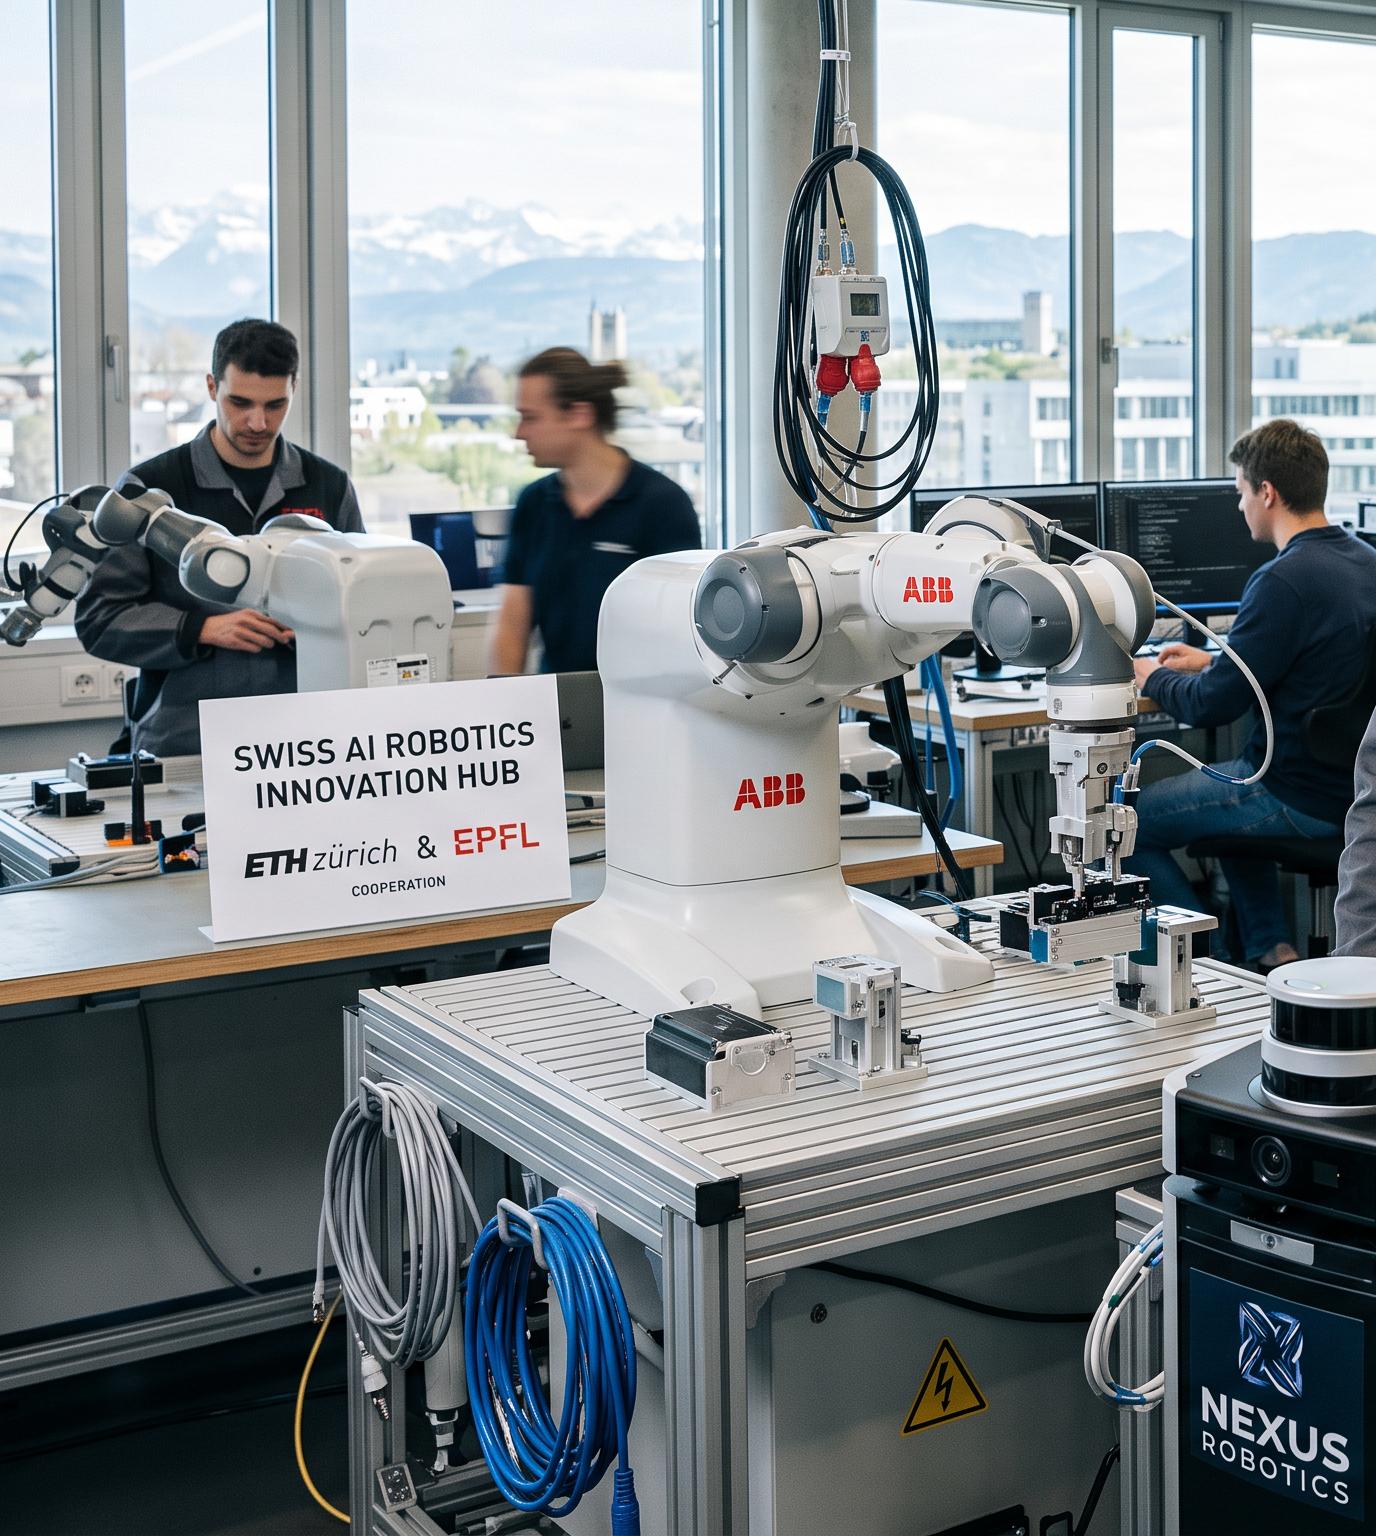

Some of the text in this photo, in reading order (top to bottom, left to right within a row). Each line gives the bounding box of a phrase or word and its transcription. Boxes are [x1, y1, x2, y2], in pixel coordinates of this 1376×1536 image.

[904, 576, 954, 603] ABB
[234, 721, 535, 772] SWISS AI ROBOTICS
[256, 759, 520, 809] INNOVATION HUB
[733, 772, 806, 811] ABB
[417, 834, 438, 859] &
[453, 822, 540, 856] EPFL
[351, 875, 446, 897] COOPERATION
[1201, 1385, 1350, 1473] NEXUS
[1203, 1430, 1349, 1505] ROBOTICS
